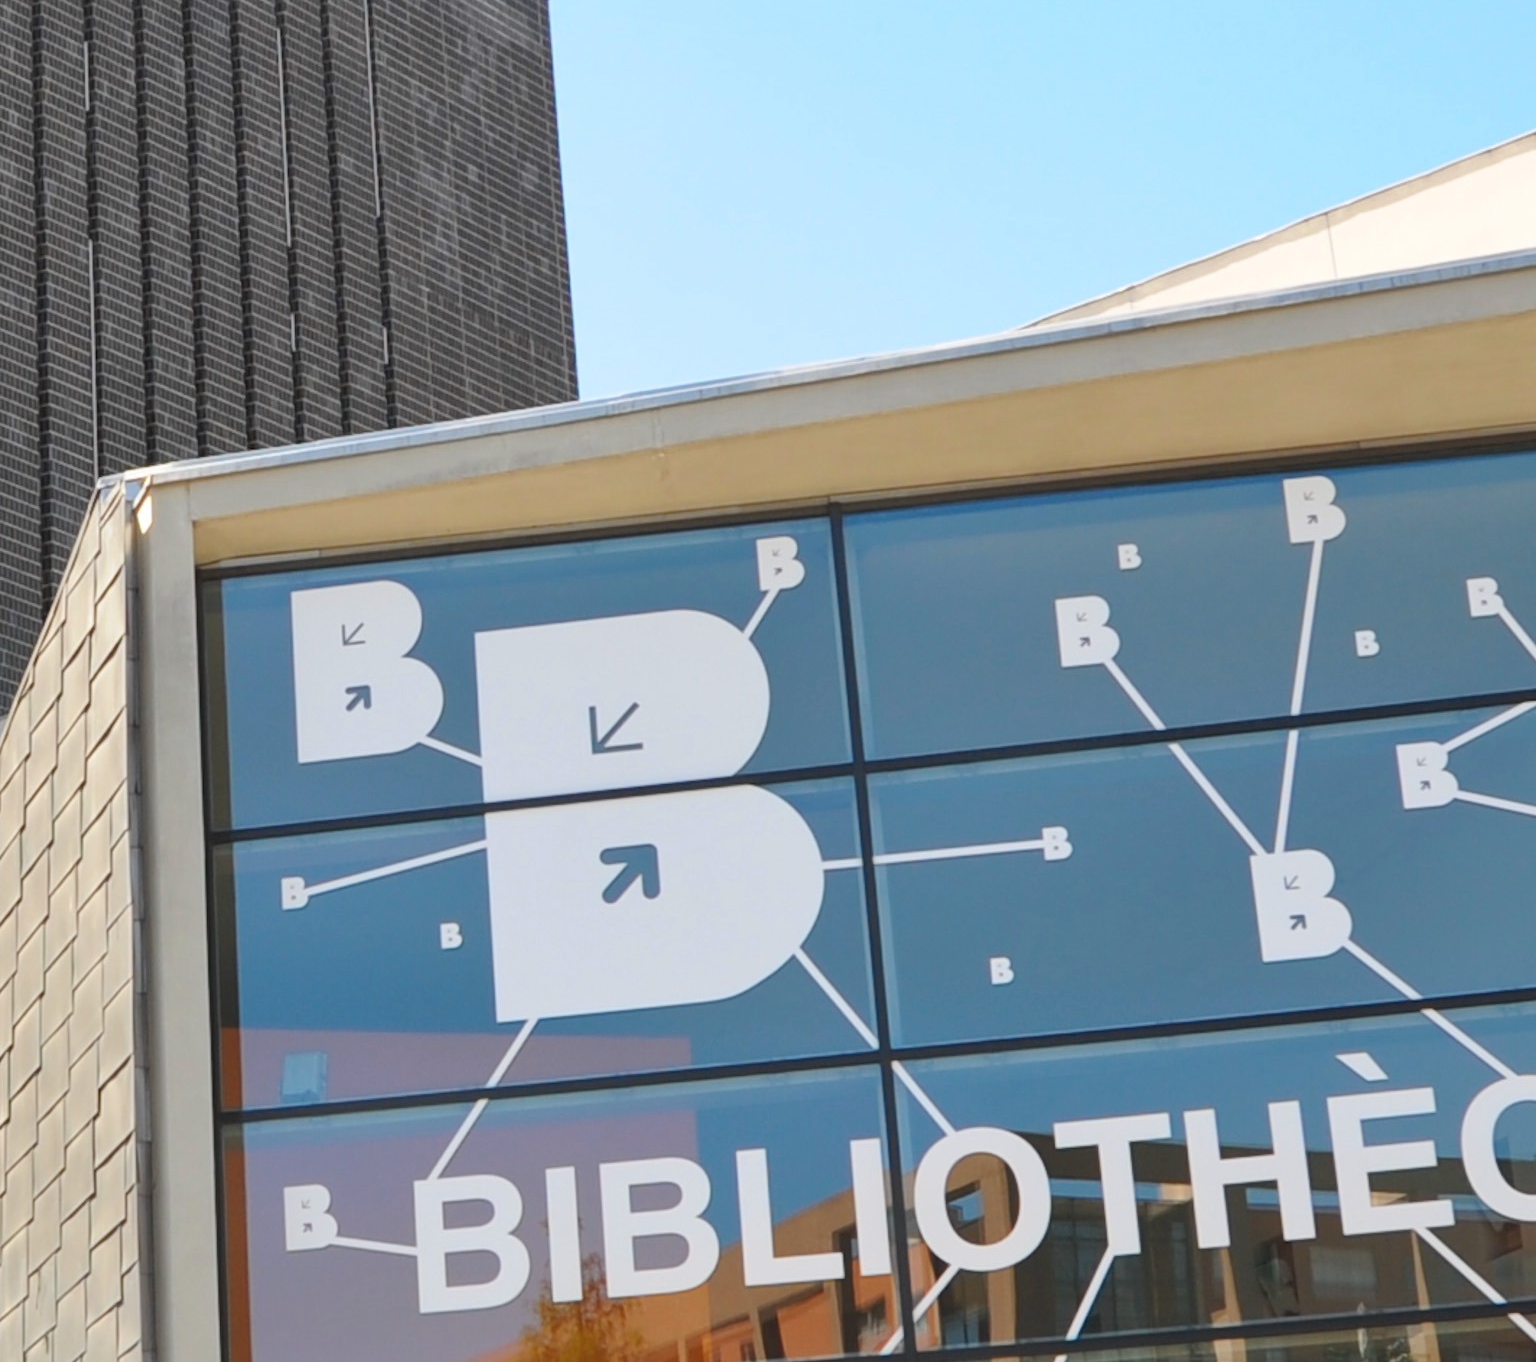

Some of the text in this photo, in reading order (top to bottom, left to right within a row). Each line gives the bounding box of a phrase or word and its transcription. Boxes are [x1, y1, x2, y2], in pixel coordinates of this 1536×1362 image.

[1283, 475, 1346, 544] B
[756, 536, 805, 591] B
[1118, 544, 1142, 569] B
[1467, 577, 1503, 617] B
[1055, 596, 1120, 668] B
[1354, 630, 1380, 656] B
[291, 579, 444, 763] B
[1396, 742, 1458, 809] B
[475, 609, 825, 1023] B
[1043, 827, 1073, 860] B
[282, 878, 309, 910] B
[1250, 849, 1352, 962] B
[440, 923, 463, 950] B
[990, 957, 1014, 985] B
[283, 1184, 339, 1252] B
